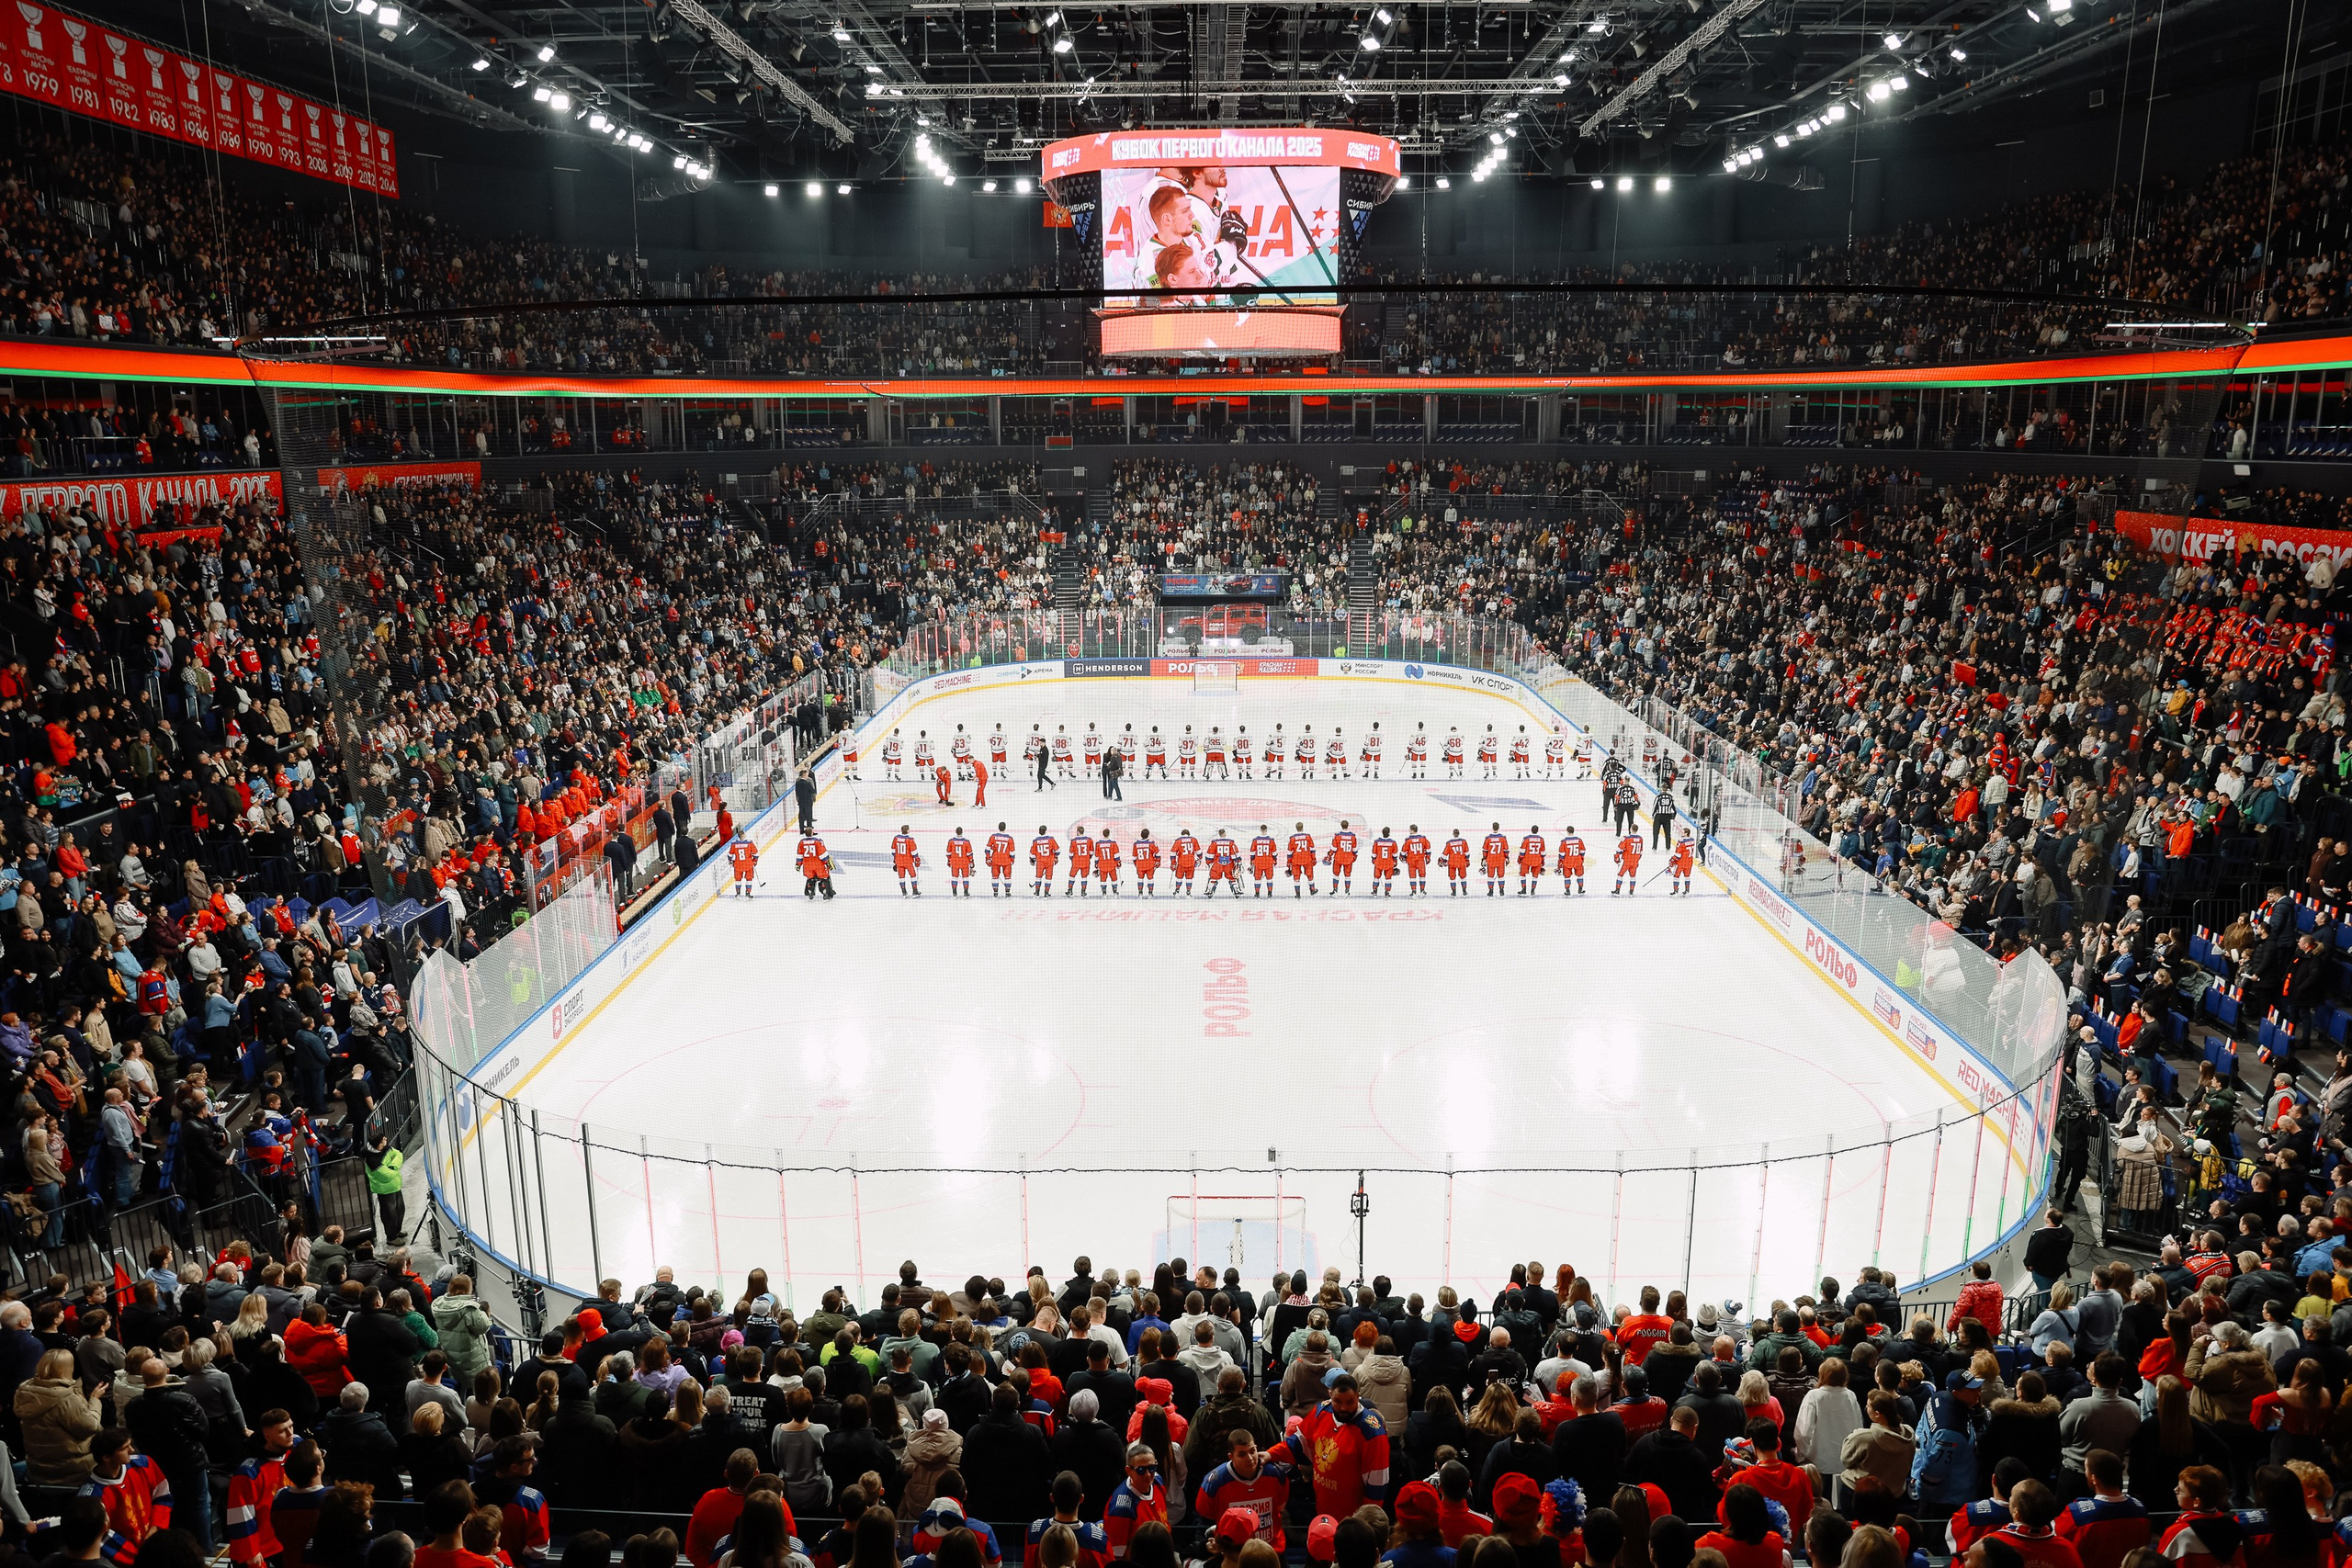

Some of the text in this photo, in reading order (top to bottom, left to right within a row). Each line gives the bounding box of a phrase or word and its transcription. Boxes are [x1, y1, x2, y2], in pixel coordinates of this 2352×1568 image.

[0, 62, 12, 84] 8
[23, 69, 59, 97] 1979
[70, 85, 99, 110] 1981
[108, 96, 141, 122] 1982
[148, 107, 175, 131] 1983
[184, 118, 209, 141] 1986
[219, 130, 241, 150] 1989
[247, 138, 273, 159] 1990
[1112, 136, 1322, 160] КУБОК ПЕРВОГО КАНАЛА 2025
[278, 145, 301, 166] 1993
[307, 154, 328, 174] 2008
[333, 162, 354, 181] 2009
[357, 170, 377, 187] 2012
[379, 176, 396, 193] 2014
[1067, 200, 1095, 213] ИБИРЬ
[1080, 211, 1093, 244] АРЕНА
[2148, 526, 2236, 560] ХОККЕЙ
[1085, 664, 1143, 672] HENDERSON
[933, 673, 973, 691] RED MACHINE
[1427, 671, 1463, 681] НОРНИКЕЛЬ
[1471, 675, 1515, 694] VK СПОРТ
[889, 741, 899, 752] 19
[920, 743, 927, 752] 11
[955, 739, 966, 749] 63
[1056, 739, 1067, 749] 88
[1086, 737, 1097, 747] 87
[1123, 737, 1134, 748] 71
[1149, 737, 1161, 747] 34
[1182, 739, 1194, 750] 97
[1237, 739, 1249, 750] 80
[1277, 738, 1283, 748] 5
[1303, 739, 1315, 749] 93
[1370, 737, 1380, 747] 81
[1449, 738, 1461, 748] 68
[1486, 737, 1497, 747] 23
[1552, 739, 1564, 750] 22
[803, 844, 817, 858] 29
[897, 842, 907, 855] 10
[956, 845, 962, 857] 4
[995, 841, 1008, 853] 77
[1036, 844, 1049, 856] 45
[1077, 844, 1088, 856] 13
[1181, 842, 1193, 855] 34
[1216, 845, 1230, 857] 99
[1257, 844, 1270, 857] 89
[1295, 840, 1307, 852] 24
[1340, 840, 1352, 852] 96
[1409, 842, 1423, 855] 44
[1489, 841, 1501, 854] 27
[1529, 842, 1541, 854] 53
[1566, 844, 1580, 856] 76
[1630, 842, 1642, 854] 70
[738, 848, 746, 861] 8
[1101, 848, 1111, 860] 11
[1136, 848, 1149, 861] 87
[1381, 847, 1388, 859] 6
[1805, 928, 1857, 989] РОЛЬФ
[564, 988, 583, 1017] СПОРТ
[1203, 957, 1251, 1037] РОЛЬФ
[479, 1055, 520, 1100] РНИКЕЛЬ
[1957, 1059, 1980, 1093] RED
[730, 1395, 766, 1408] TREAT
[1935, 1450, 1953, 1465] 73
